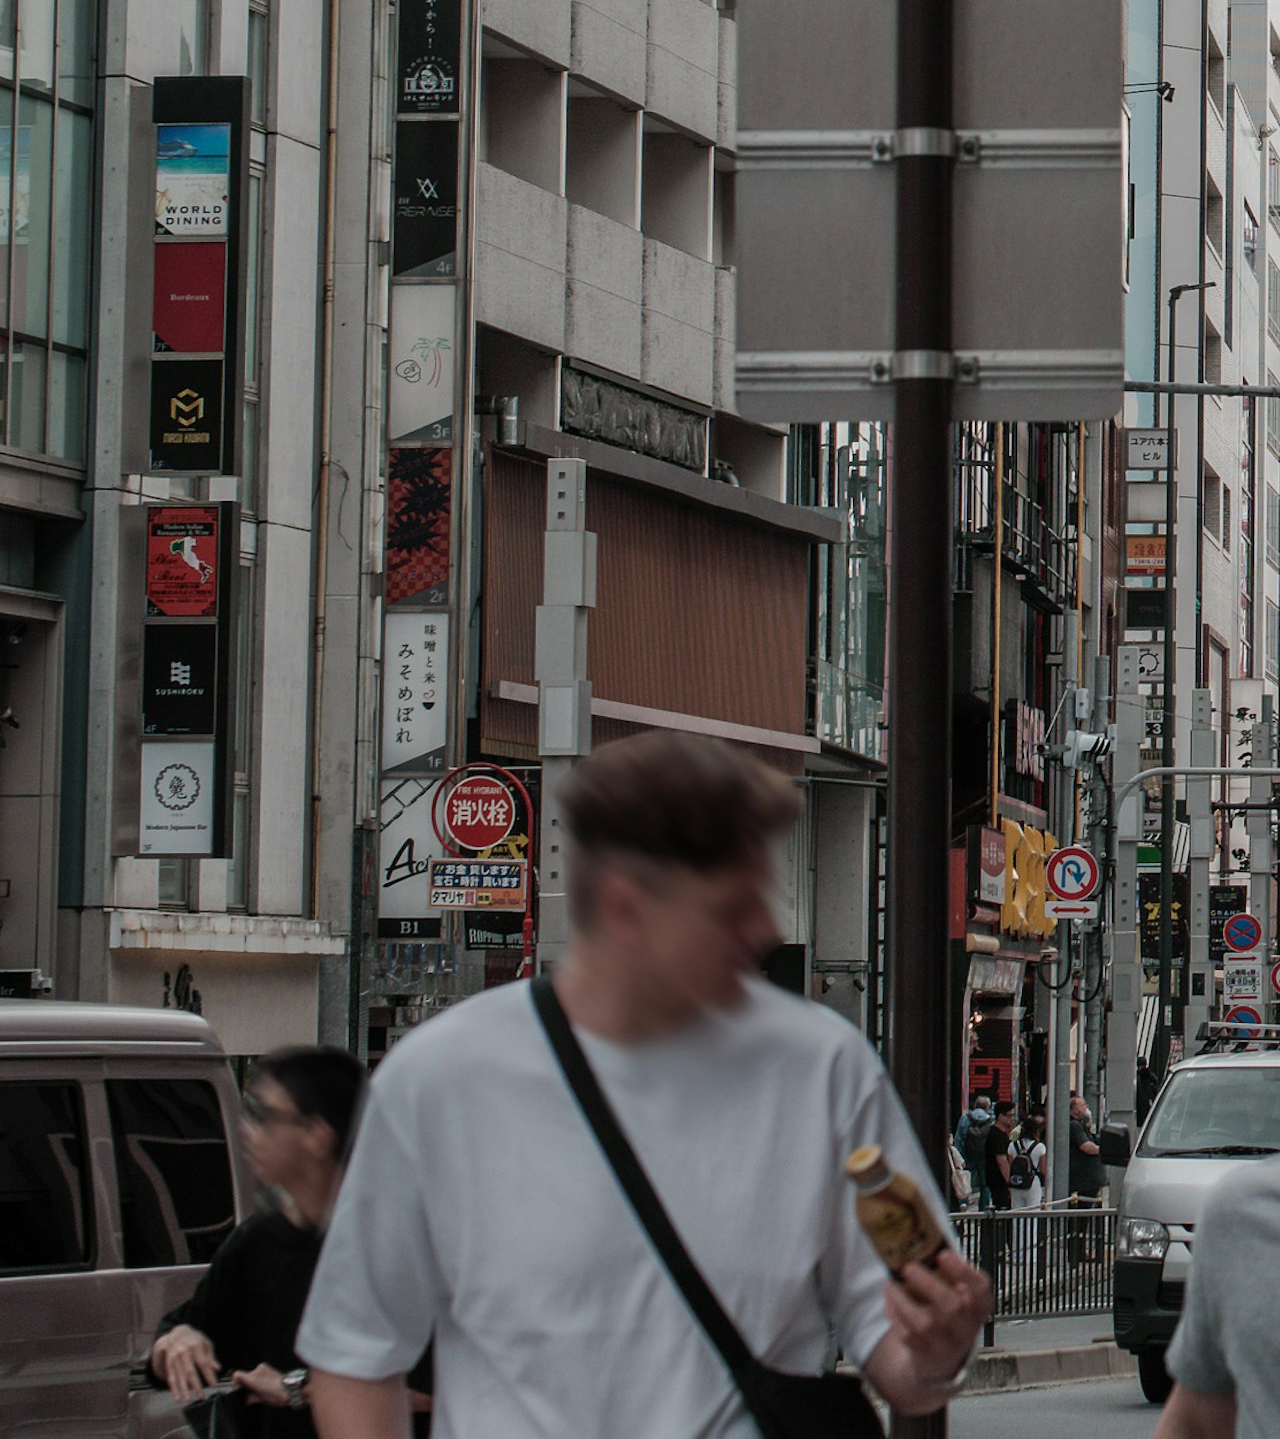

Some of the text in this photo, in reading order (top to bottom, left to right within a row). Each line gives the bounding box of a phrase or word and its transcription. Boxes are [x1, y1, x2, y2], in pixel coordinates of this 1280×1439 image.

[165, 205, 222, 214] WORLD
[165, 216, 222, 225] DINING
[436, 261, 453, 274] 4F
[170, 293, 210, 301] Bordeaux
[432, 424, 450, 439] 3F
[1130, 437, 1169, 446] ユア六本
[1142, 451, 1162, 461] ビル
[430, 590, 447, 603] 2F
[424, 624, 437, 684] 味噌と米
[155, 688, 205, 696] SUSHIROKU
[427, 755, 443, 769] 1F
[457, 786, 503, 794] FIRE HYDRANT
[452, 799, 509, 827] 消火栓
[143, 842, 153, 852] 3F
[399, 920, 420, 934] B1
